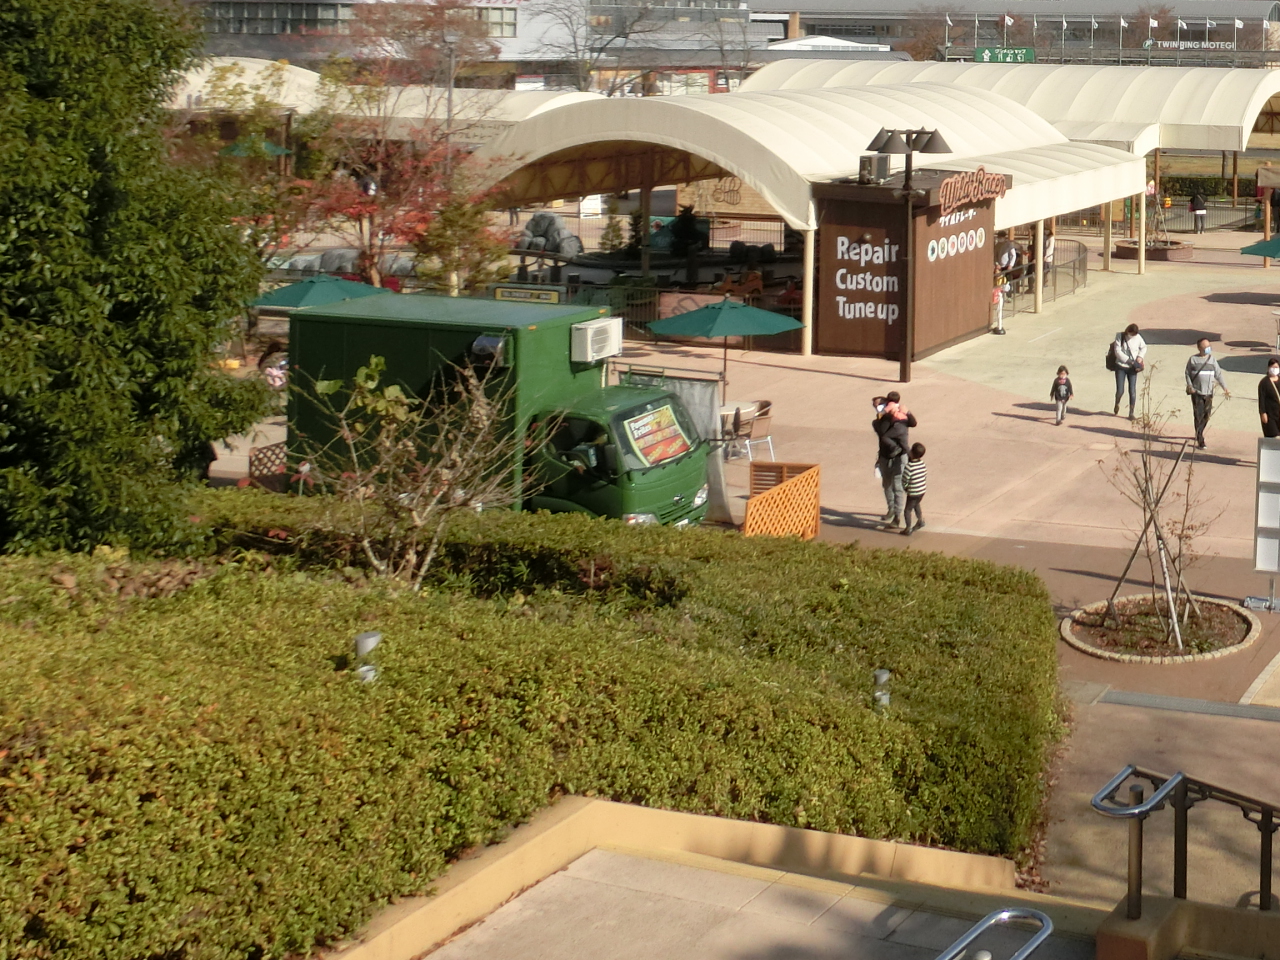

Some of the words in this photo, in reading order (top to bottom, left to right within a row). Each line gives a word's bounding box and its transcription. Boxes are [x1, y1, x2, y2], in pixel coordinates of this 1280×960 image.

[1201, 41, 1235, 50] MOTEGI
[836, 236, 900, 267] Repair
[835, 268, 899, 292] Custom
[835, 295, 876, 319] Tune
[876, 303, 899, 325] up
